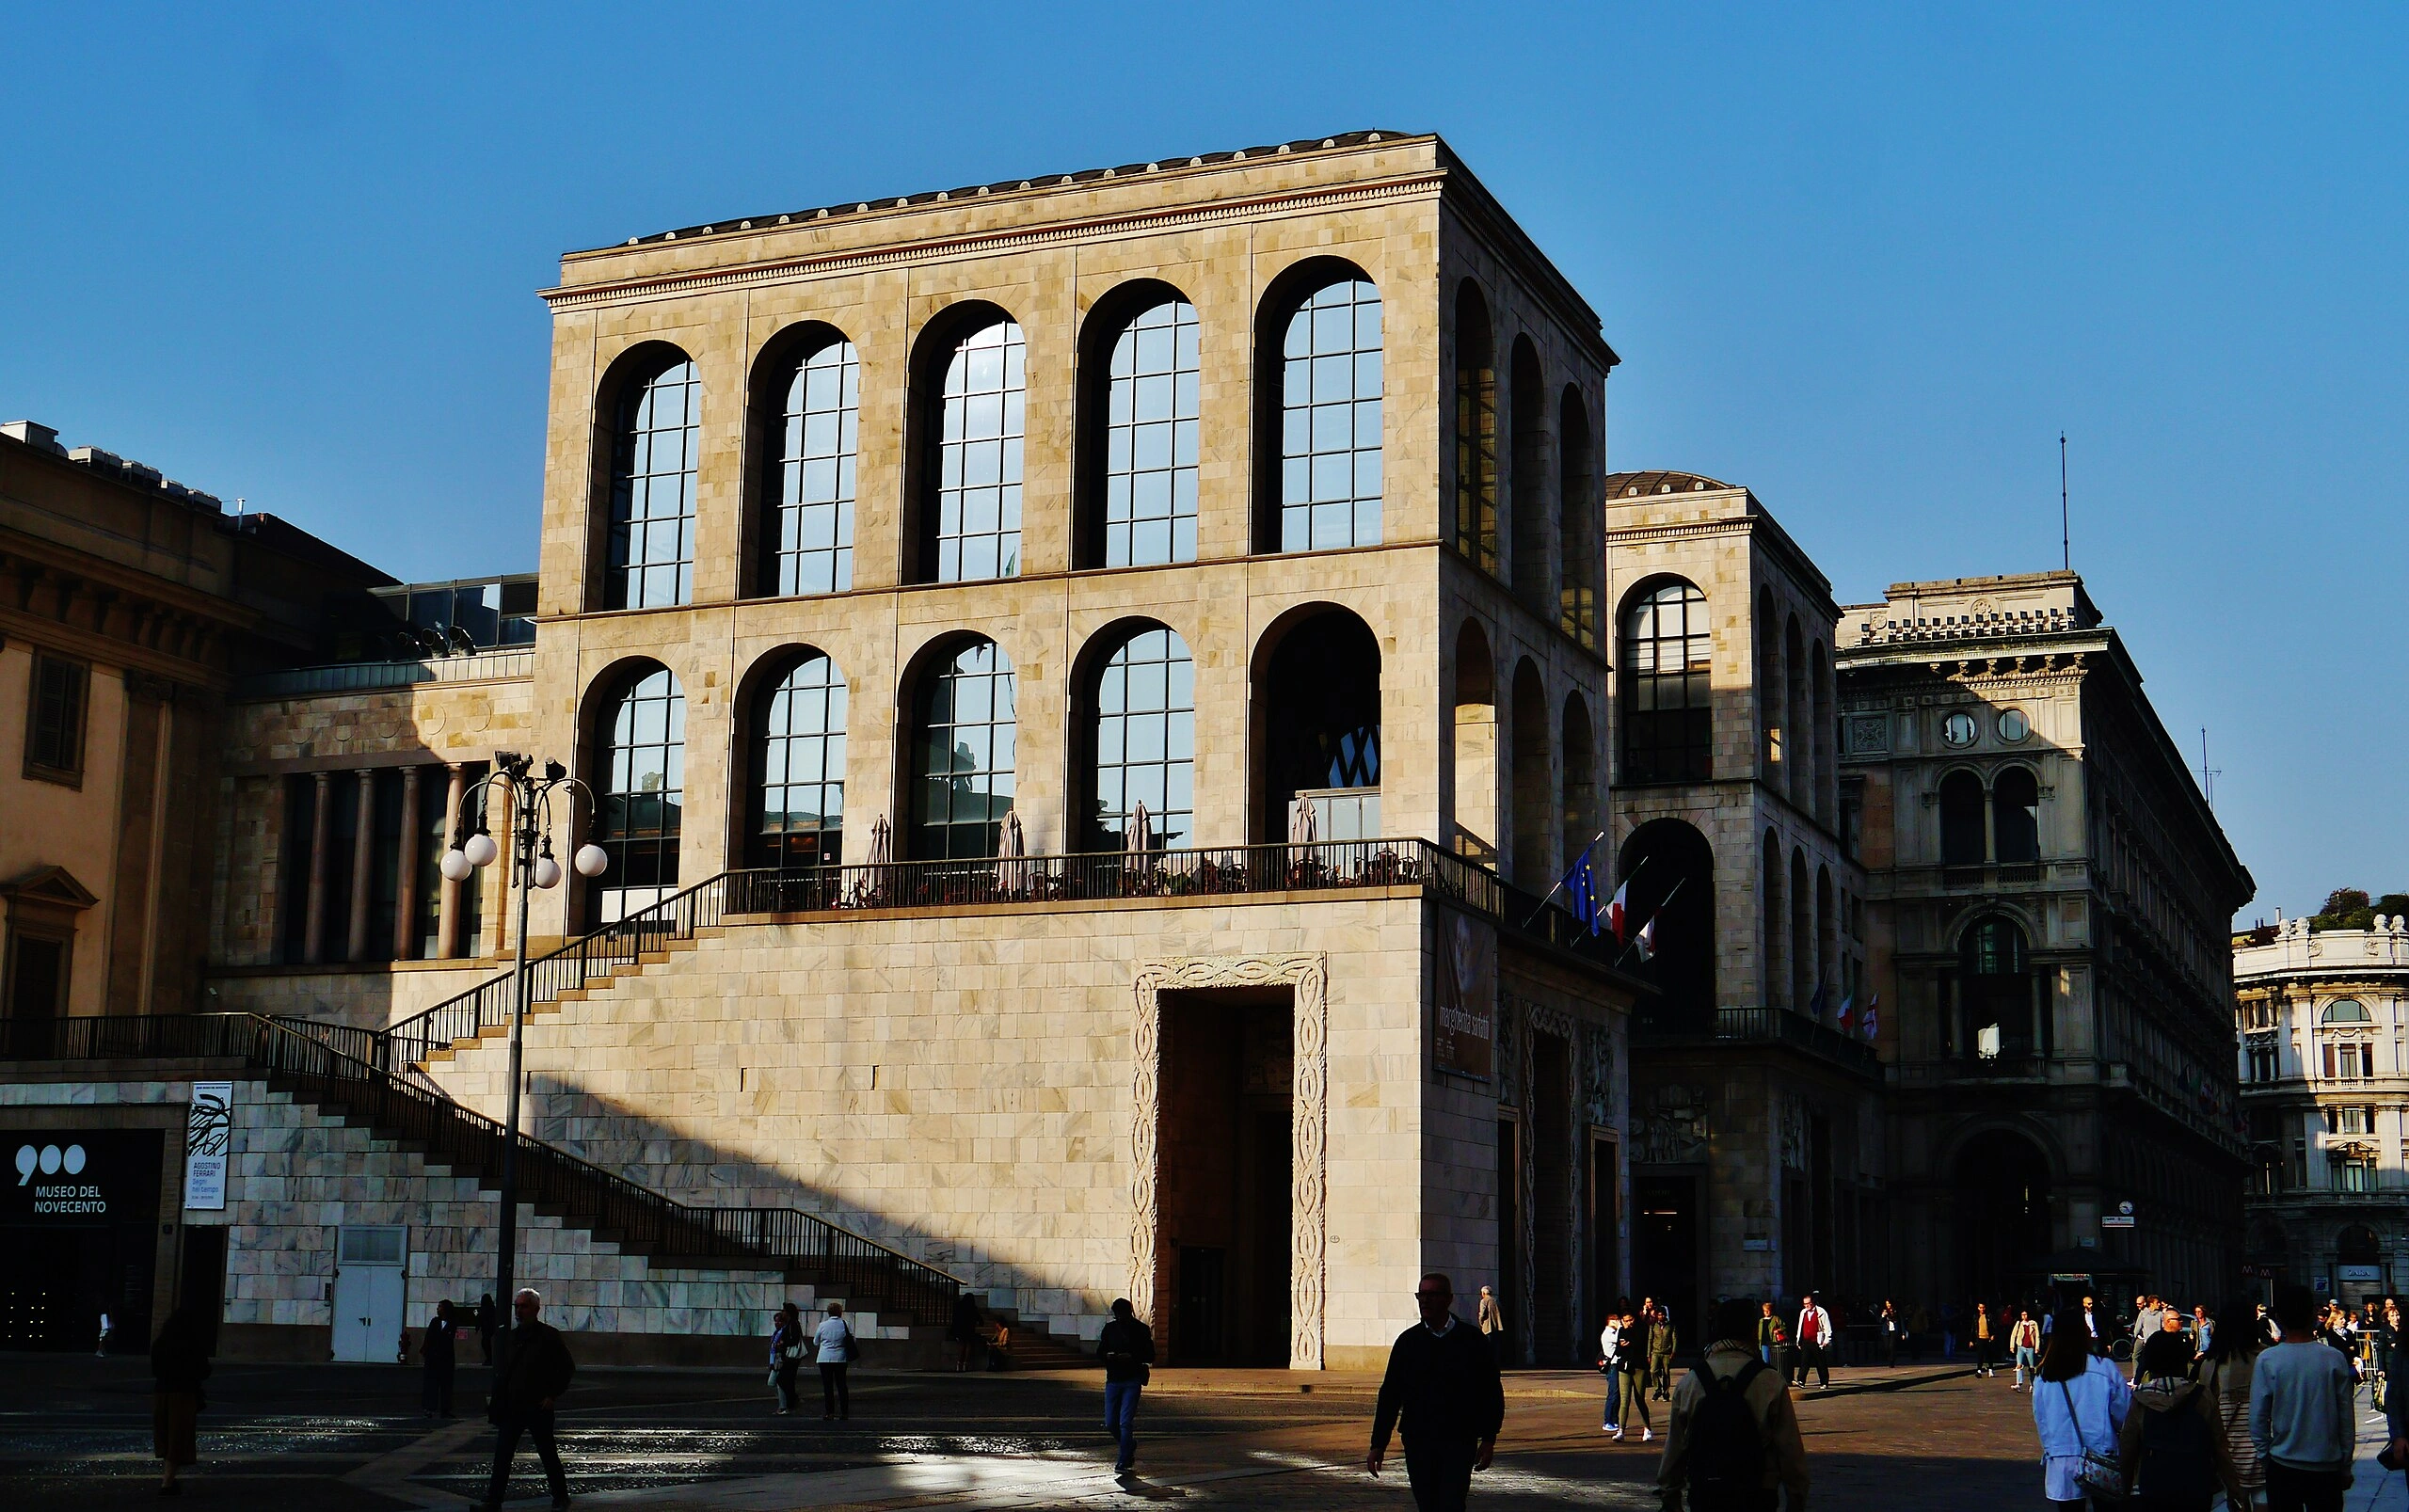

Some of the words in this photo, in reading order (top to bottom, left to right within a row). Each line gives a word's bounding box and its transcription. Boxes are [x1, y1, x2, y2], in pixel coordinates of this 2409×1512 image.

[15, 1144, 86, 1186] 900
[35, 1186, 76, 1198] MUSEO
[79, 1186, 101, 1198] DEL
[34, 1201, 106, 1213] NOVECENTO
